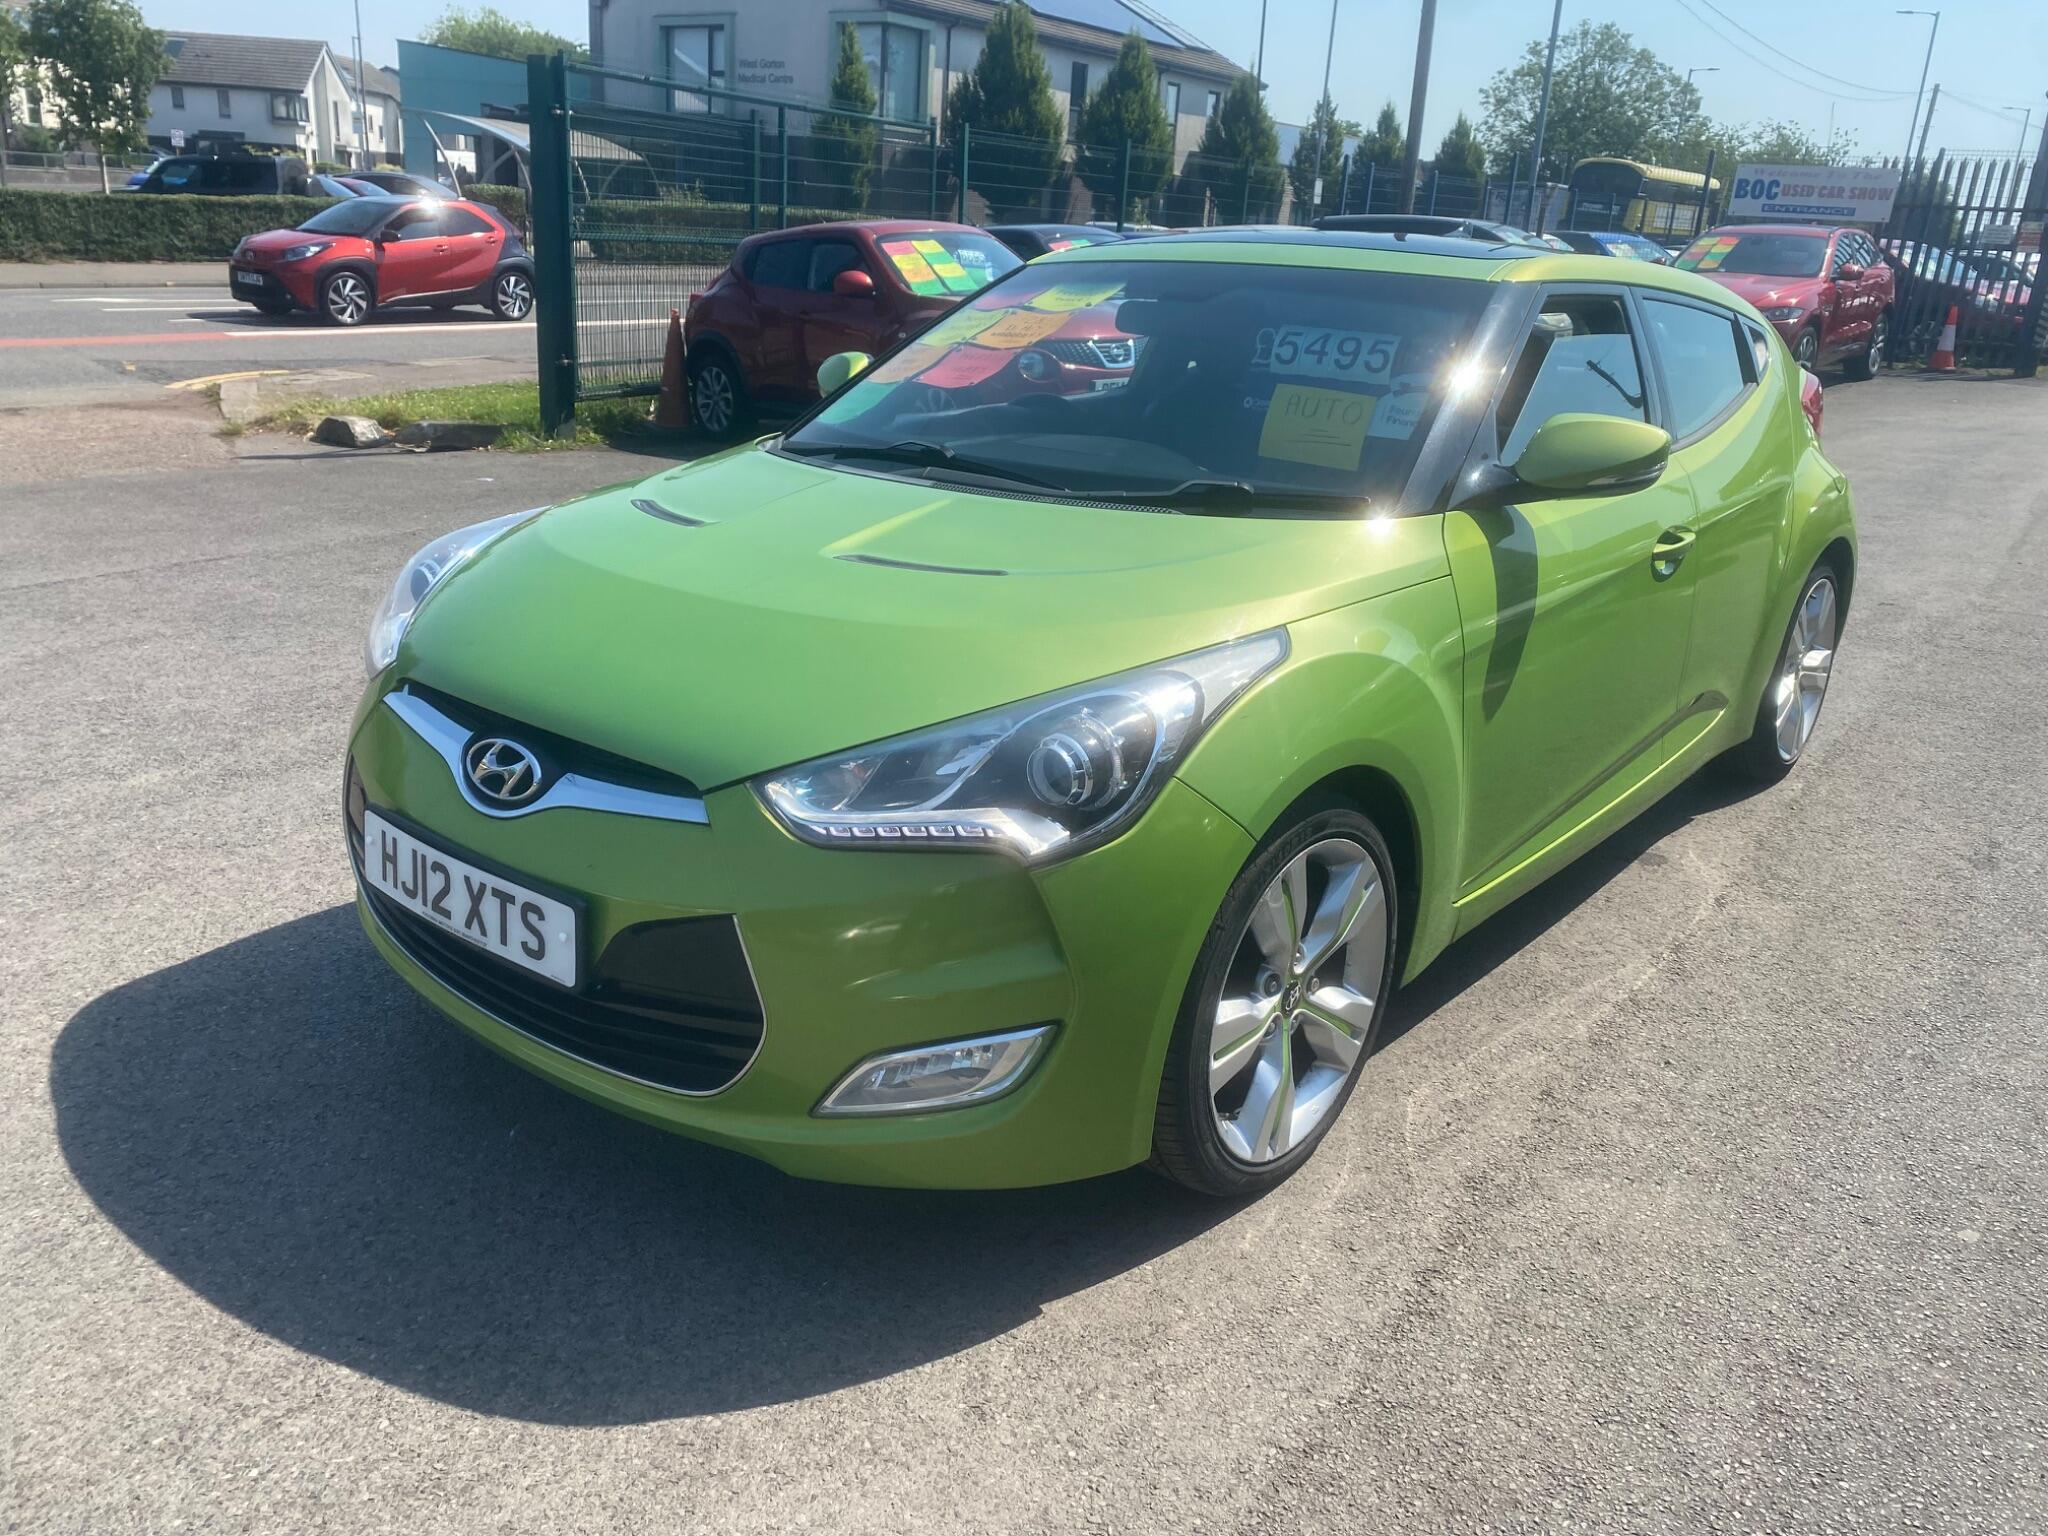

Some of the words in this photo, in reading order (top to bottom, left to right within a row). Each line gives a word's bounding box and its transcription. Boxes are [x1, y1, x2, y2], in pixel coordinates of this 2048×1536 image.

[738, 59, 758, 69] West
[760, 58, 786, 69] Gorton
[738, 72, 767, 84] Medical
[768, 72, 794, 84] Centre
[1754, 167, 1822, 178] Welcome
[1734, 177, 1781, 201] BOC
[1781, 183, 1816, 198] USED
[1817, 185, 1845, 199] CAR
[1848, 186, 1894, 200] SHOW
[1284, 393, 1363, 425] AUTO
[381, 829, 452, 921] HJ12
[463, 874, 546, 961] XTS
